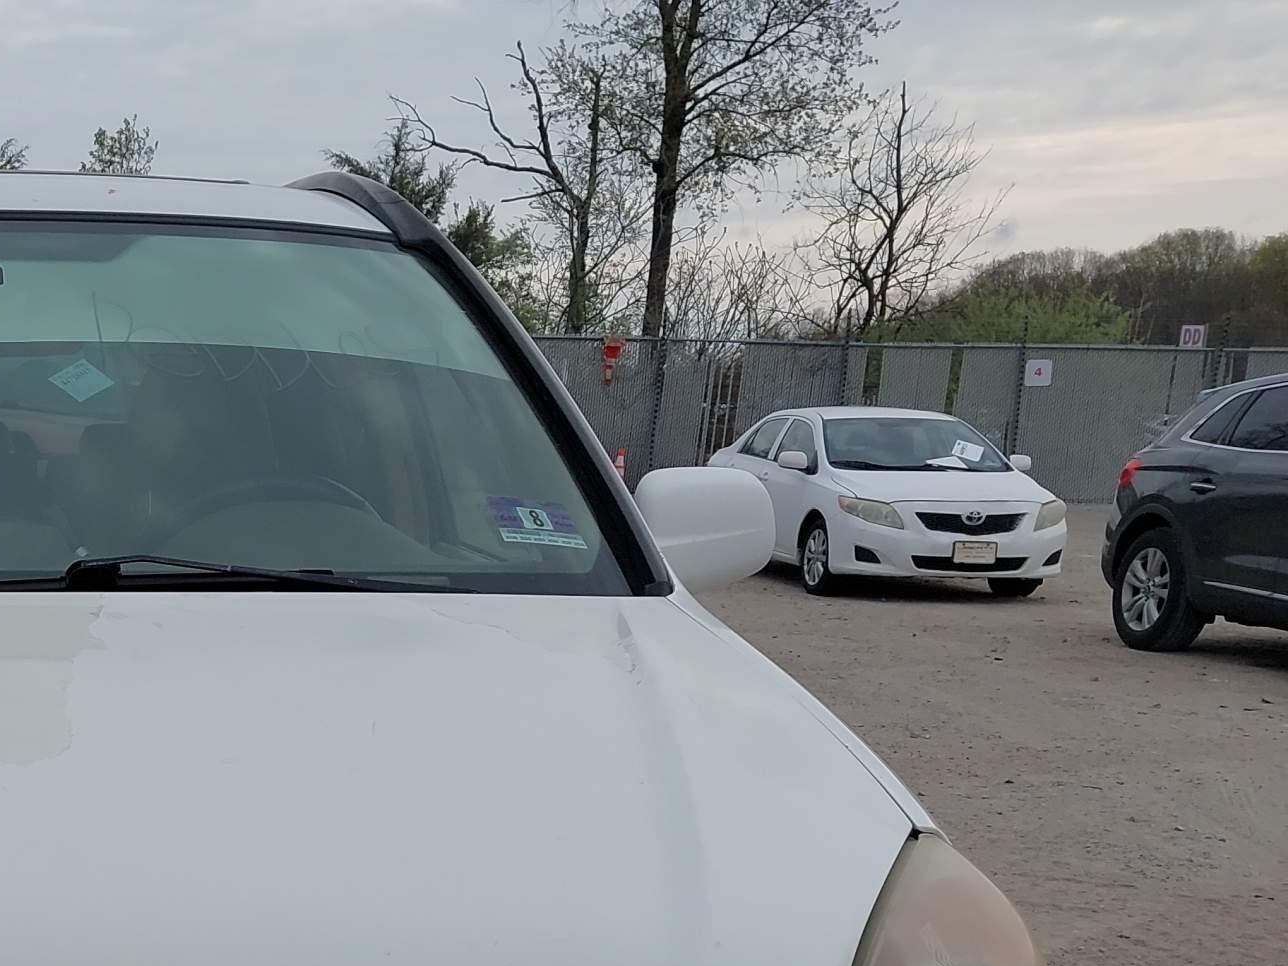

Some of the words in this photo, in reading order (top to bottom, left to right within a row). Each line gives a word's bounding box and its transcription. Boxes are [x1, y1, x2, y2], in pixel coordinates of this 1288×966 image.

[1183, 328, 1201, 346] DD
[1034, 367, 1042, 377] 4
[528, 509, 545, 527] 8
